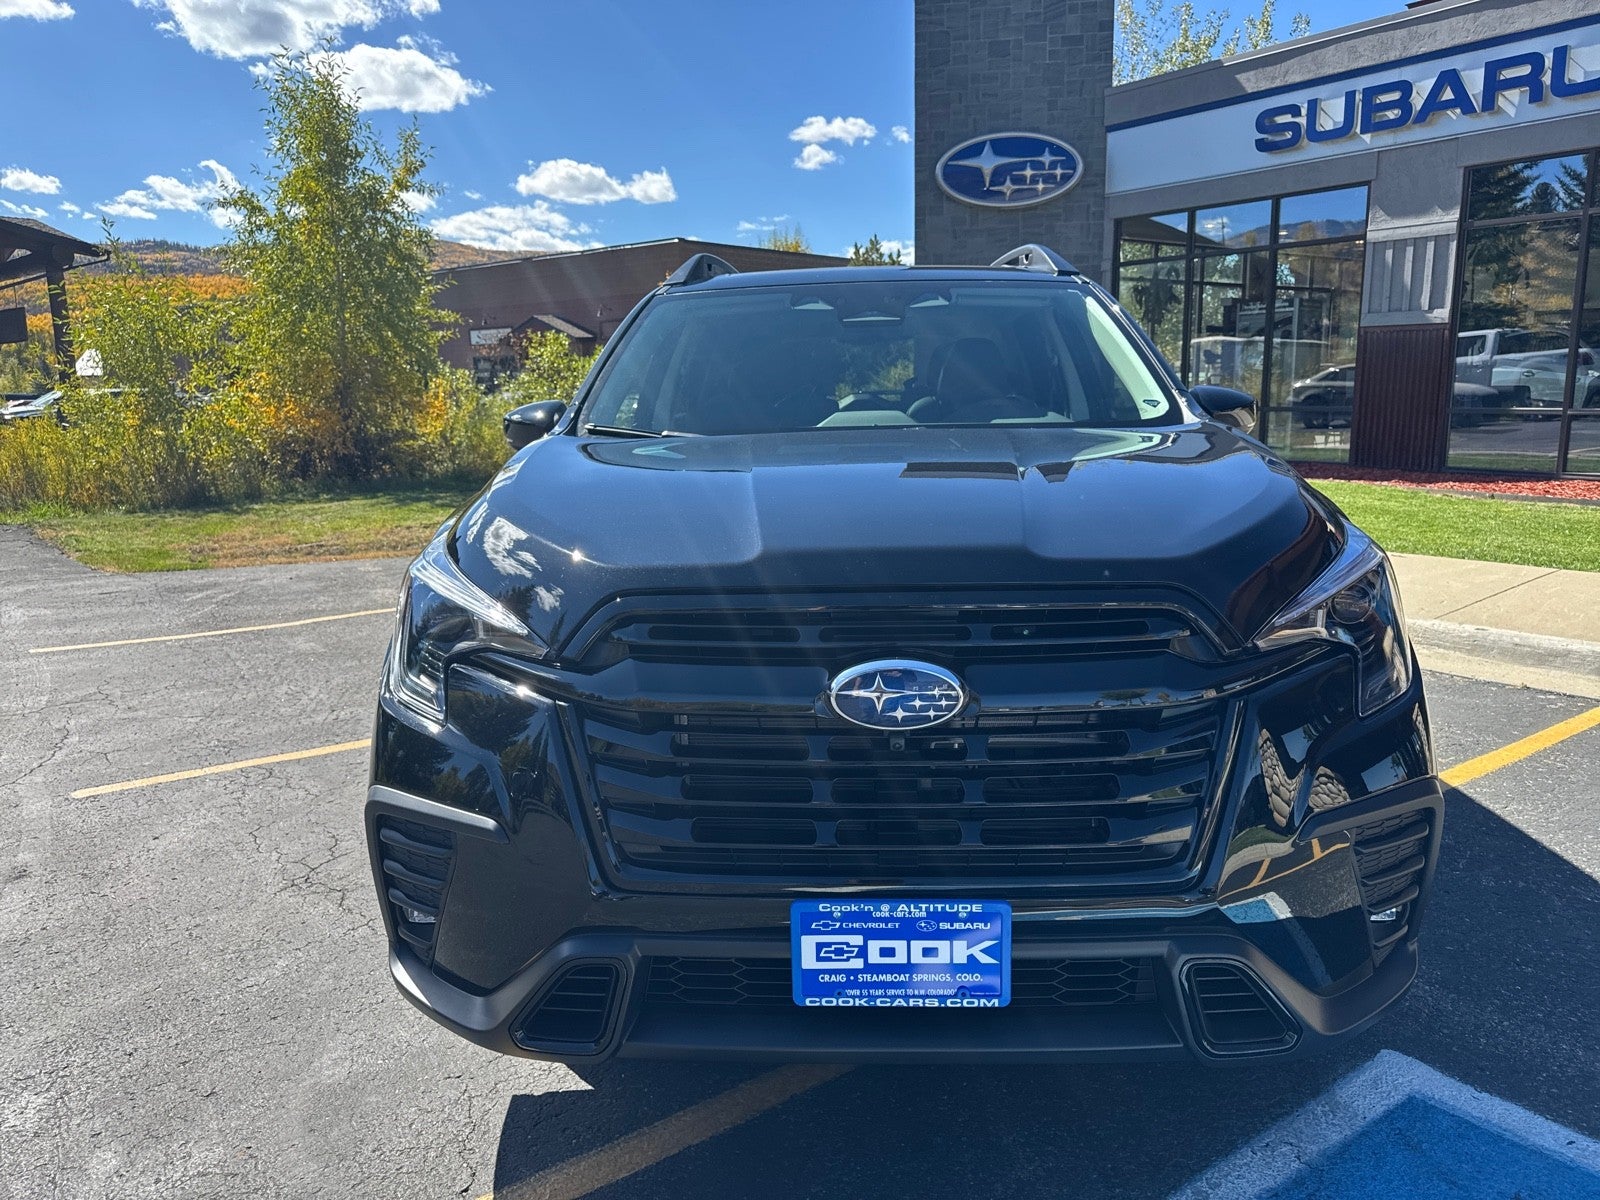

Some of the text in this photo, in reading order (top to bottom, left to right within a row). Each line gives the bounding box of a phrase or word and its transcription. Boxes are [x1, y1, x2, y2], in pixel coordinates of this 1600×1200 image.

[818, 903, 983, 913] Cook'n @ ALTITUDE
[939, 922, 991, 930] SUBARU
[801, 935, 1000, 969] COOK
[818, 973, 984, 983] CRAIG STEAMBOAT SPRINGS, COLO.
[869, 988, 886, 996] YEARS
[886, 988, 906, 996] SERVICE
[906, 988, 914, 996] TO
[805, 997, 999, 1007] COOK-CARS.COM
